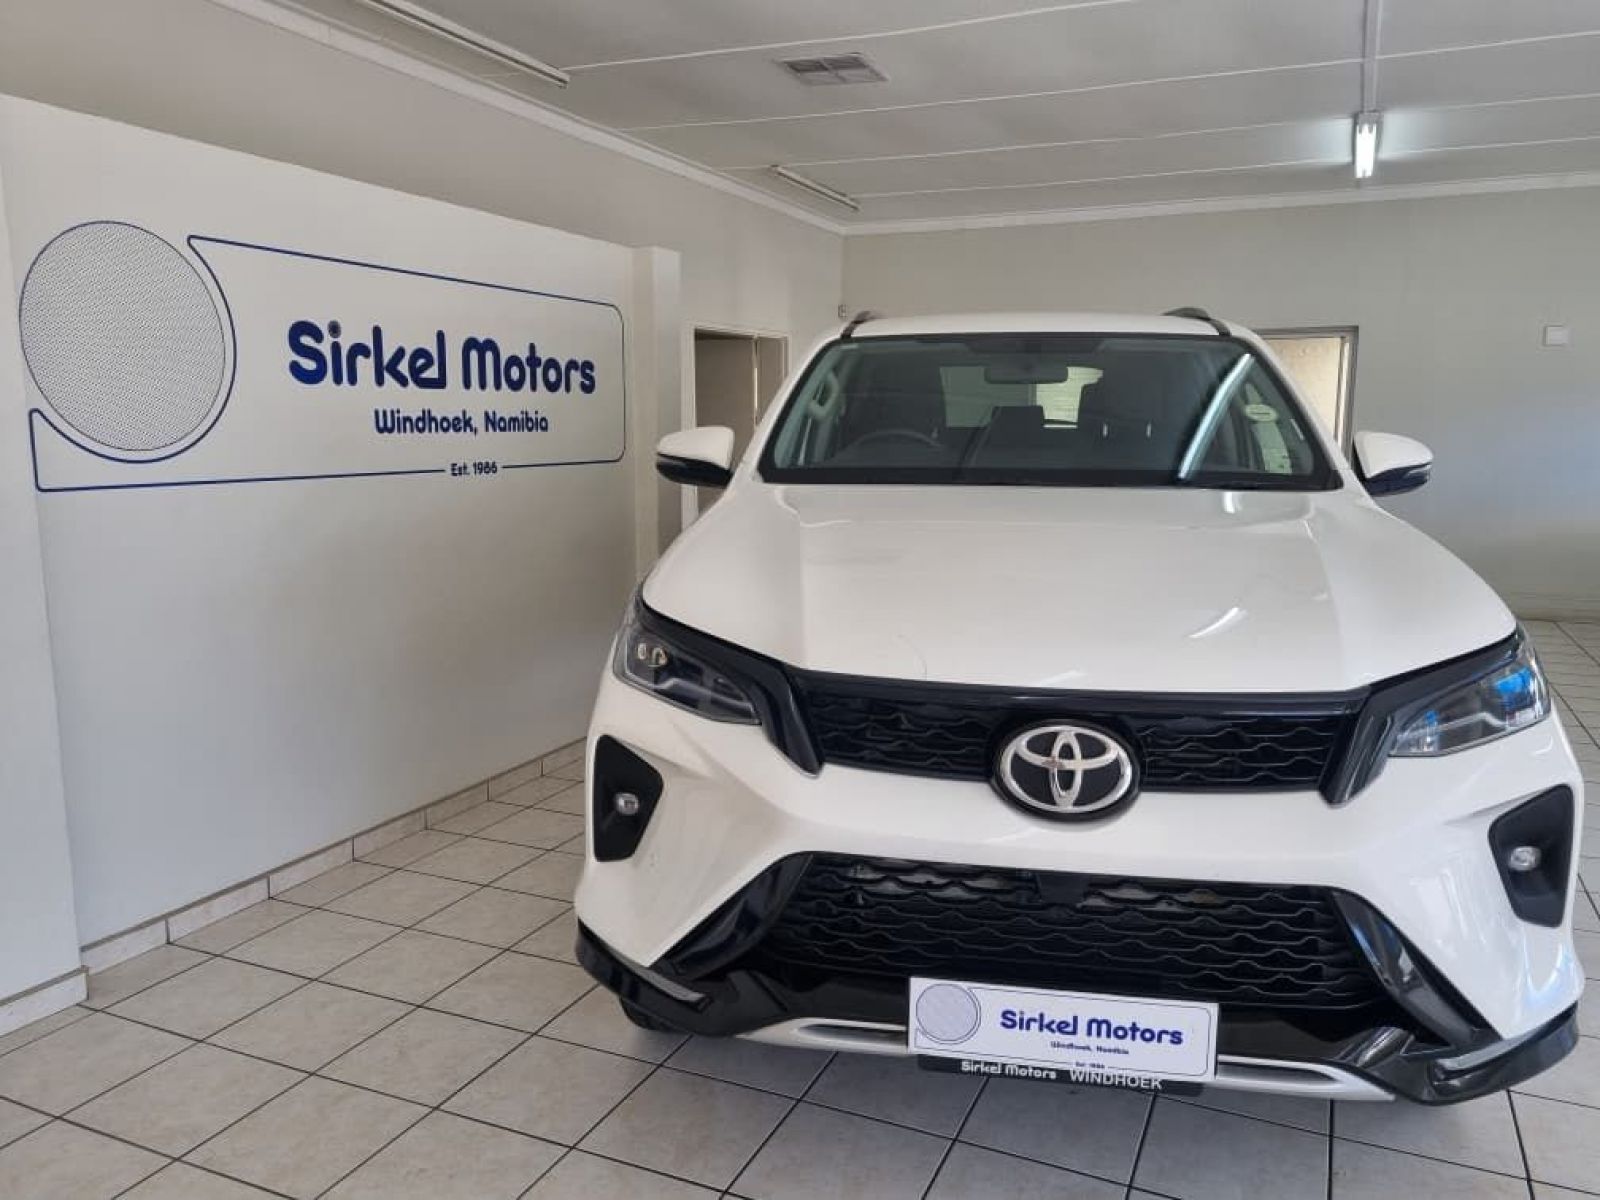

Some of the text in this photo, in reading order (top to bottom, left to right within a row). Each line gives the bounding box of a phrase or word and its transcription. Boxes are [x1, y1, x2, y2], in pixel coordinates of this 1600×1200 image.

[288, 320, 596, 394] Sirkel Motors
[374, 408, 549, 437] Windhoek, Namibia
[451, 461, 498, 477] Est. 1986
[1000, 1008, 1183, 1046] Sirkel Motors
[961, 1060, 1001, 1074] Sirkel
[1005, 1064, 1057, 1080] Motors
[1069, 1069, 1163, 1090] WINDHOEK
